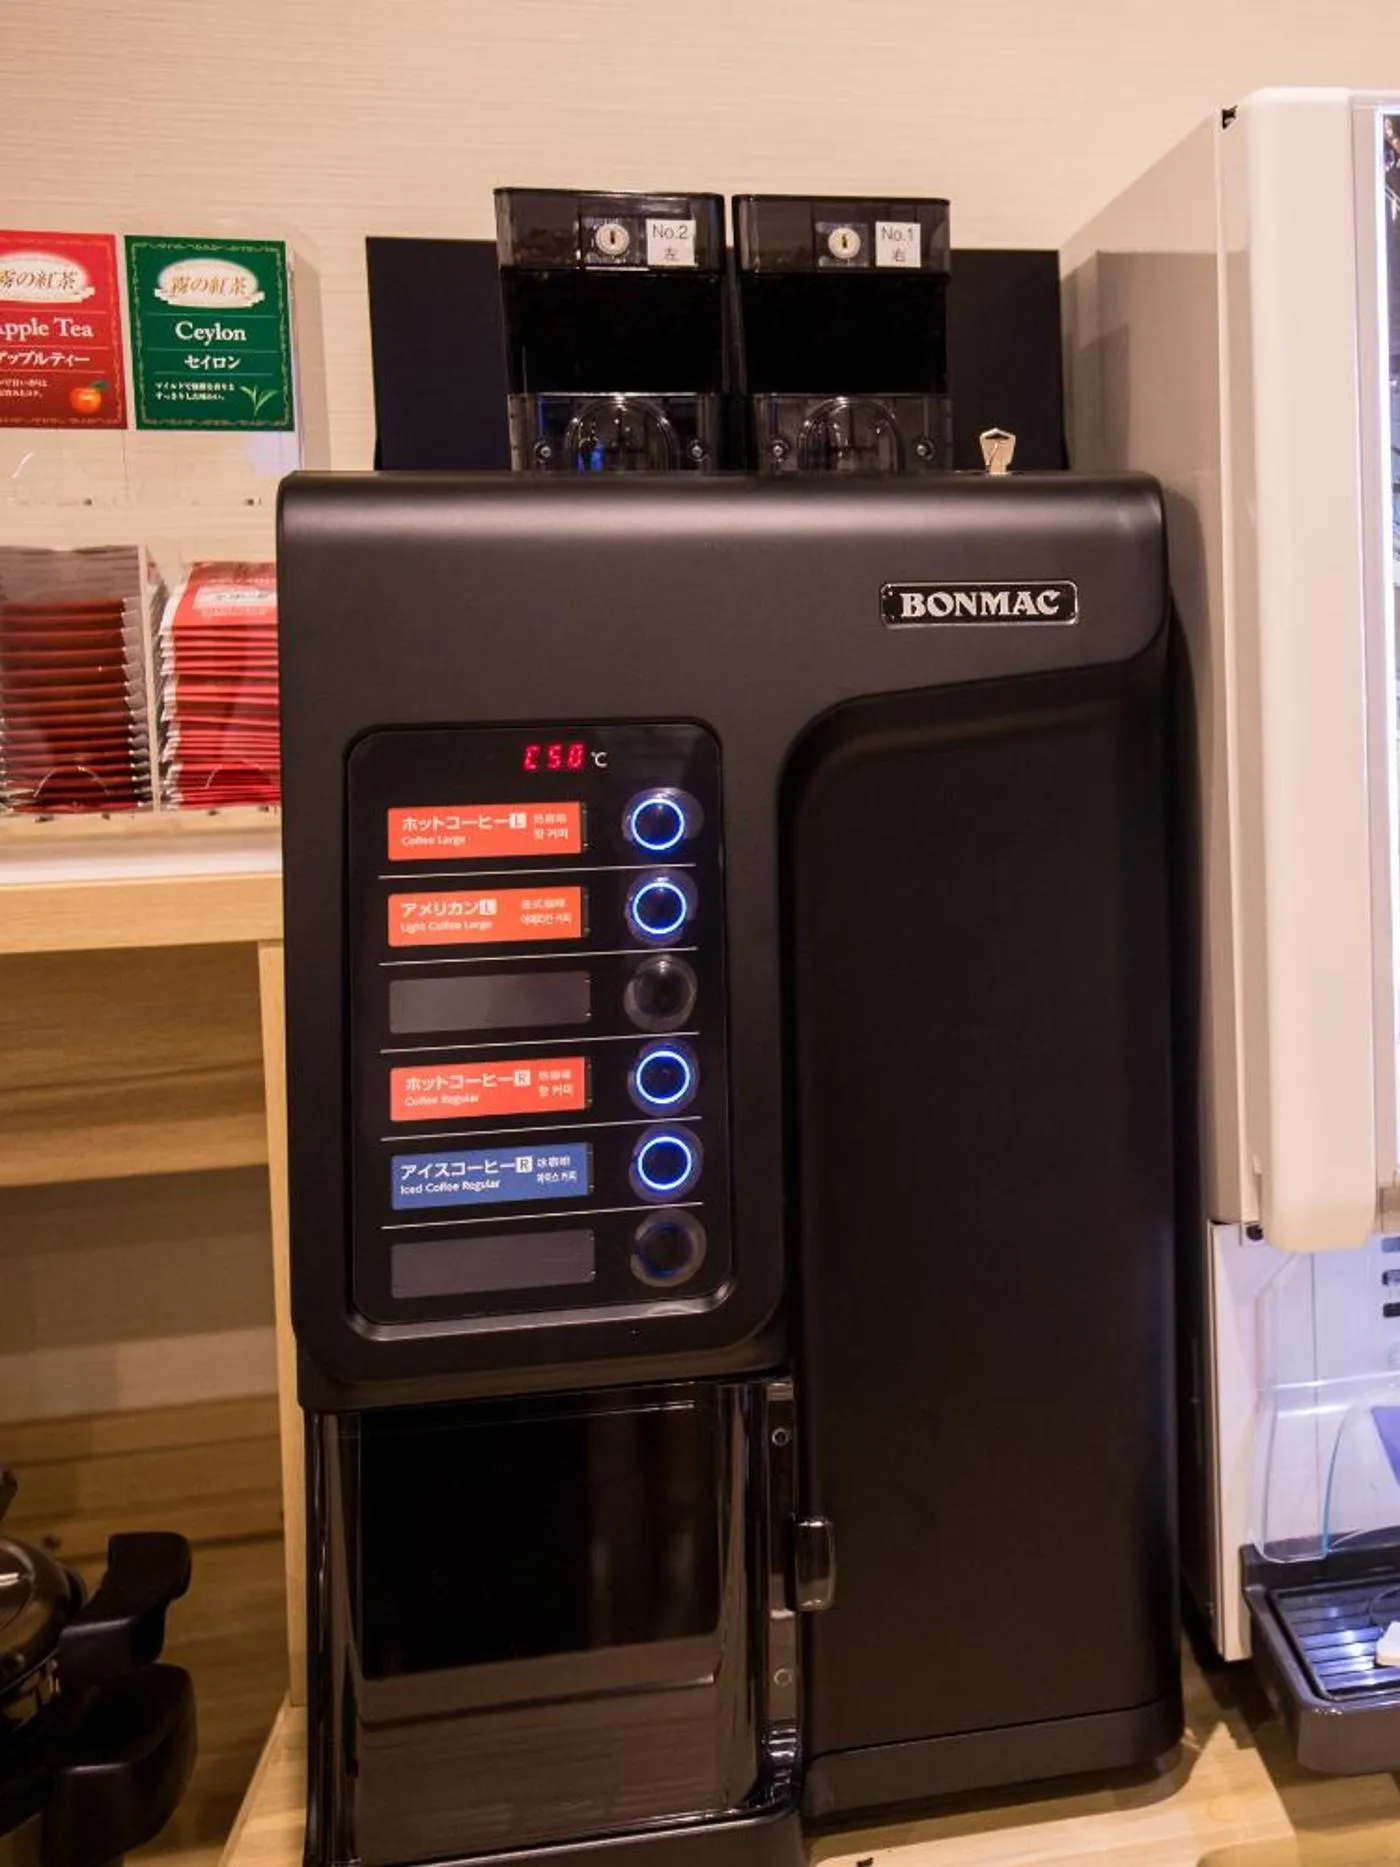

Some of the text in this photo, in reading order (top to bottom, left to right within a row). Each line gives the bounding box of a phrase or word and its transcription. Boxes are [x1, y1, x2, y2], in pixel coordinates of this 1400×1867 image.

[882, 225, 913, 242] No.1
[53, 316, 94, 338] Tea
[175, 320, 247, 346] Ceylon
[184, 354, 241, 370] セイロン
[900, 589, 1061, 617] BONMAC
[400, 1179, 500, 1195] Iced Coffee Regular
